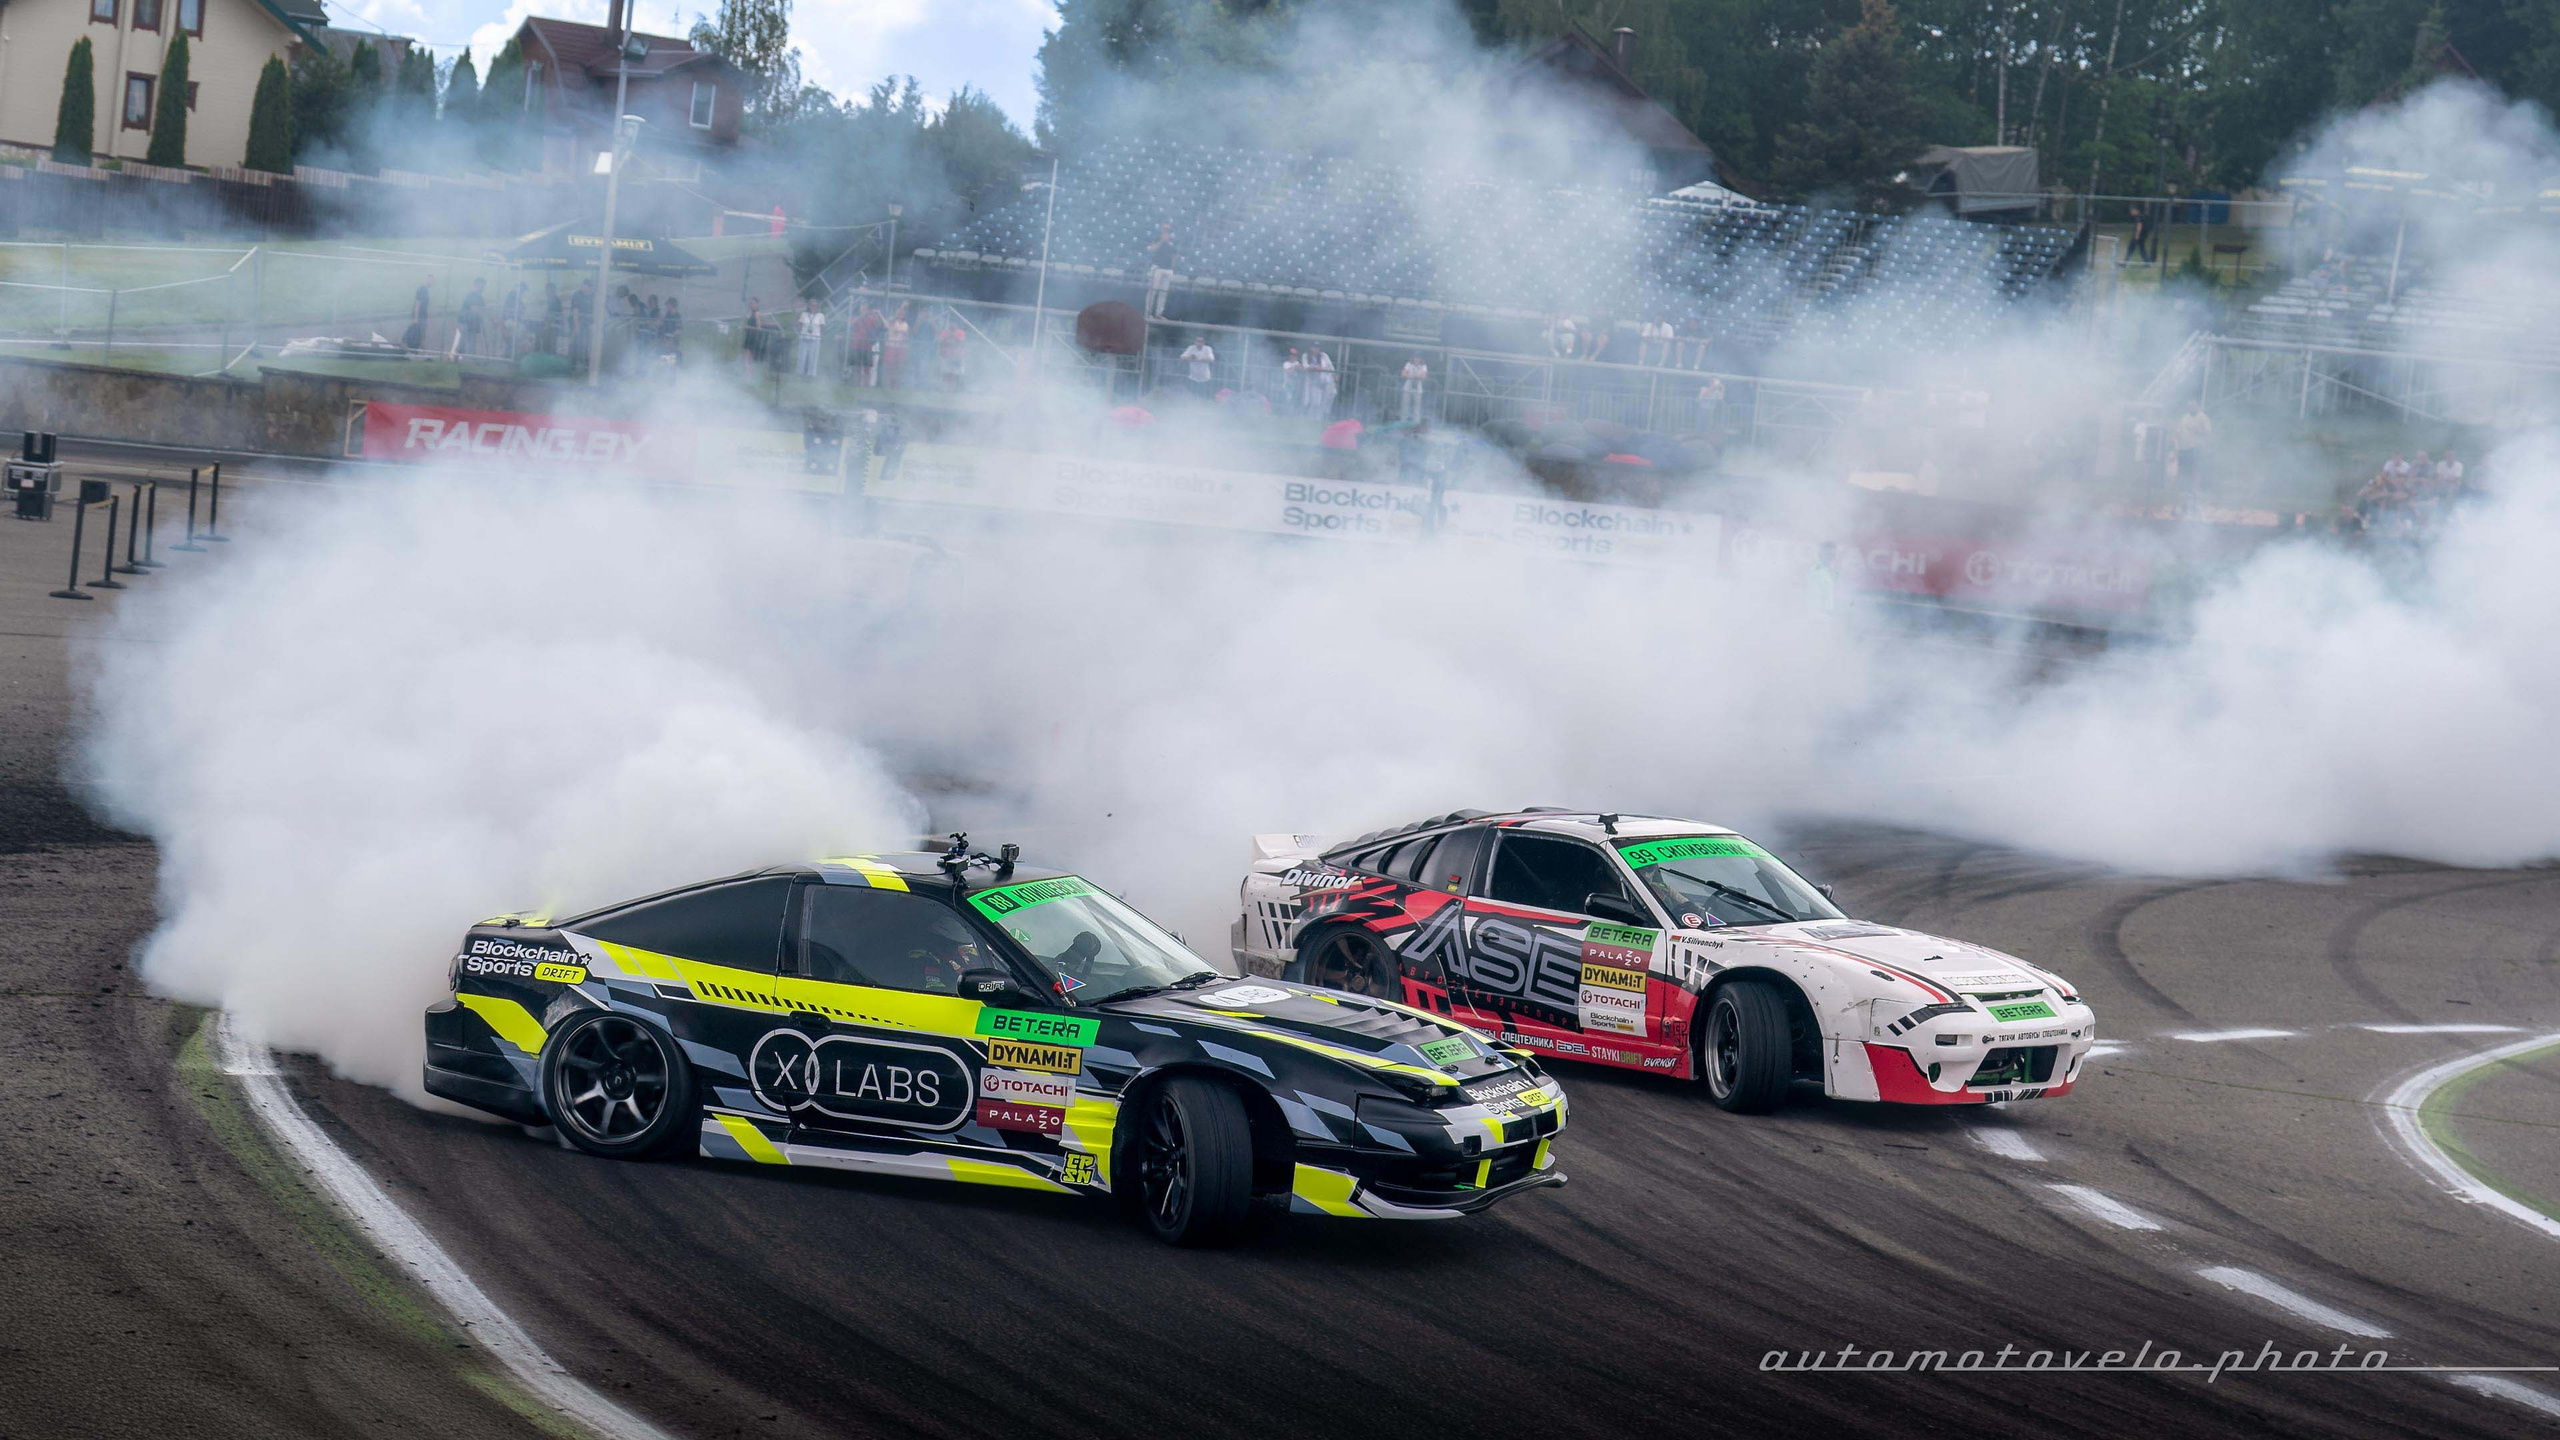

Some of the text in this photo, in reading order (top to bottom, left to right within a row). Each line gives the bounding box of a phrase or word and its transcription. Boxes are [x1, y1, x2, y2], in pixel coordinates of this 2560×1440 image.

[404, 417, 652, 463] RACING.BY
[1283, 506, 1381, 533] Sports
[1514, 503, 1676, 536] Blockchain
[1629, 849, 1657, 864] 99
[471, 940, 577, 964] Blockchain
[1401, 904, 1583, 1015] ASE
[467, 956, 579, 980] Sports DRIFT
[1594, 994, 1640, 1010] TOTACHI
[1590, 1012, 1630, 1024] Blockchain
[1591, 1019, 1616, 1028] Sports
[1500, 1031, 1554, 1049] СПЕЦТЕХНИКА
[1557, 1040, 1589, 1055] EDEL
[835, 1059, 940, 1107] LABS
[1001, 1079, 1068, 1097] TOTACHI
[1466, 1080, 1526, 1102] Blockchain
[1481, 1091, 1547, 1117] Sports DRIFT
[989, 1109, 1060, 1130] PALAZZO
